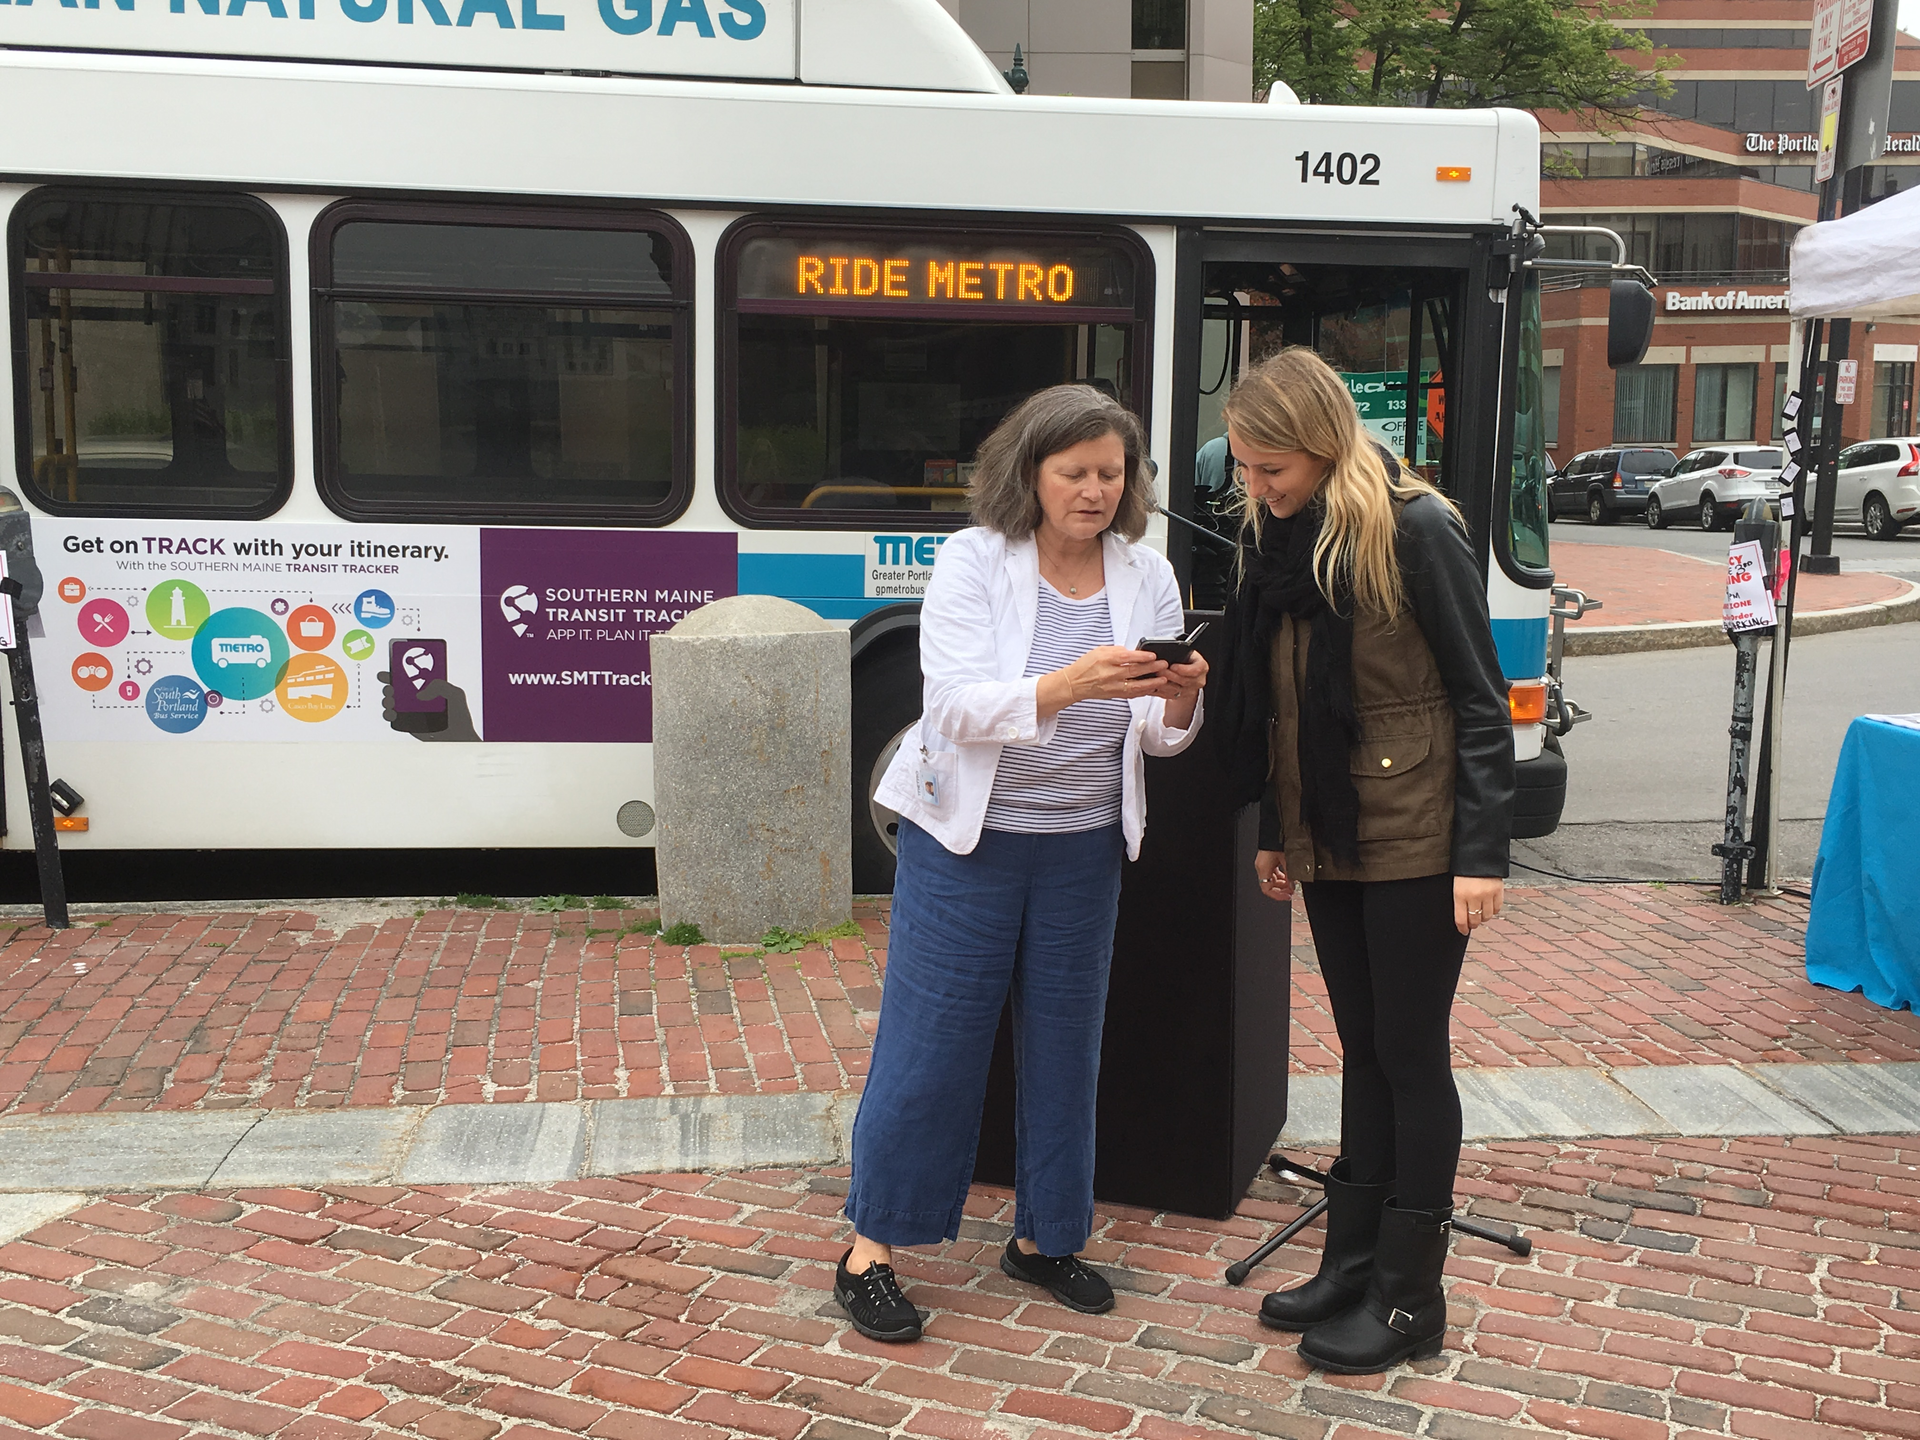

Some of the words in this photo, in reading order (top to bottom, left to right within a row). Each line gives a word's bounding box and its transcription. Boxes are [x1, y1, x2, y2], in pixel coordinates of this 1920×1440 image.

[170, 0, 565, 31] URAL
[599, 0, 766, 41] GAS
[1746, 133, 1774, 152] The
[1778, 134, 1819, 154] Portla
[1295, 151, 1381, 185] 1402
[798, 256, 910, 297] RIDE
[929, 261, 1074, 302] METRO
[1665, 291, 1715, 311] Bank
[1714, 290, 1736, 310] of
[1735, 290, 1791, 310] Ameri
[1391, 435, 1424, 446] REIL
[63, 536, 104, 554] Get
[110, 540, 138, 554] on
[142, 537, 226, 555] TRACK
[233, 539, 284, 556] with
[291, 542, 342, 560] your
[350, 540, 449, 562] itinerary.
[116, 561, 144, 570] With
[148, 561, 167, 570] the
[171, 561, 238, 572] SOUTHERN
[242, 563, 282, 572] MAINE
[286, 563, 339, 573] TRANSIT
[342, 564, 399, 574] TRACKER
[872, 569, 905, 580] Greater
[545, 588, 648, 603] SOUTHERN
[655, 590, 714, 603] MAINE
[876, 584, 925, 596] gpmetrobus
[546, 608, 627, 622] TRANSIT
[547, 629, 575, 640] APP
[579, 629, 593, 640] IT.
[597, 629, 635, 641] PLAN
[219, 643, 264, 653] METRO
[508, 671, 651, 686] www.SMTTrack
[152, 687, 181, 703] South
[157, 699, 199, 712] Portland
[288, 702, 306, 710] Casco
[308, 702, 319, 712] Bay
[320, 702, 336, 710] Lines
[170, 712, 199, 720] Service
